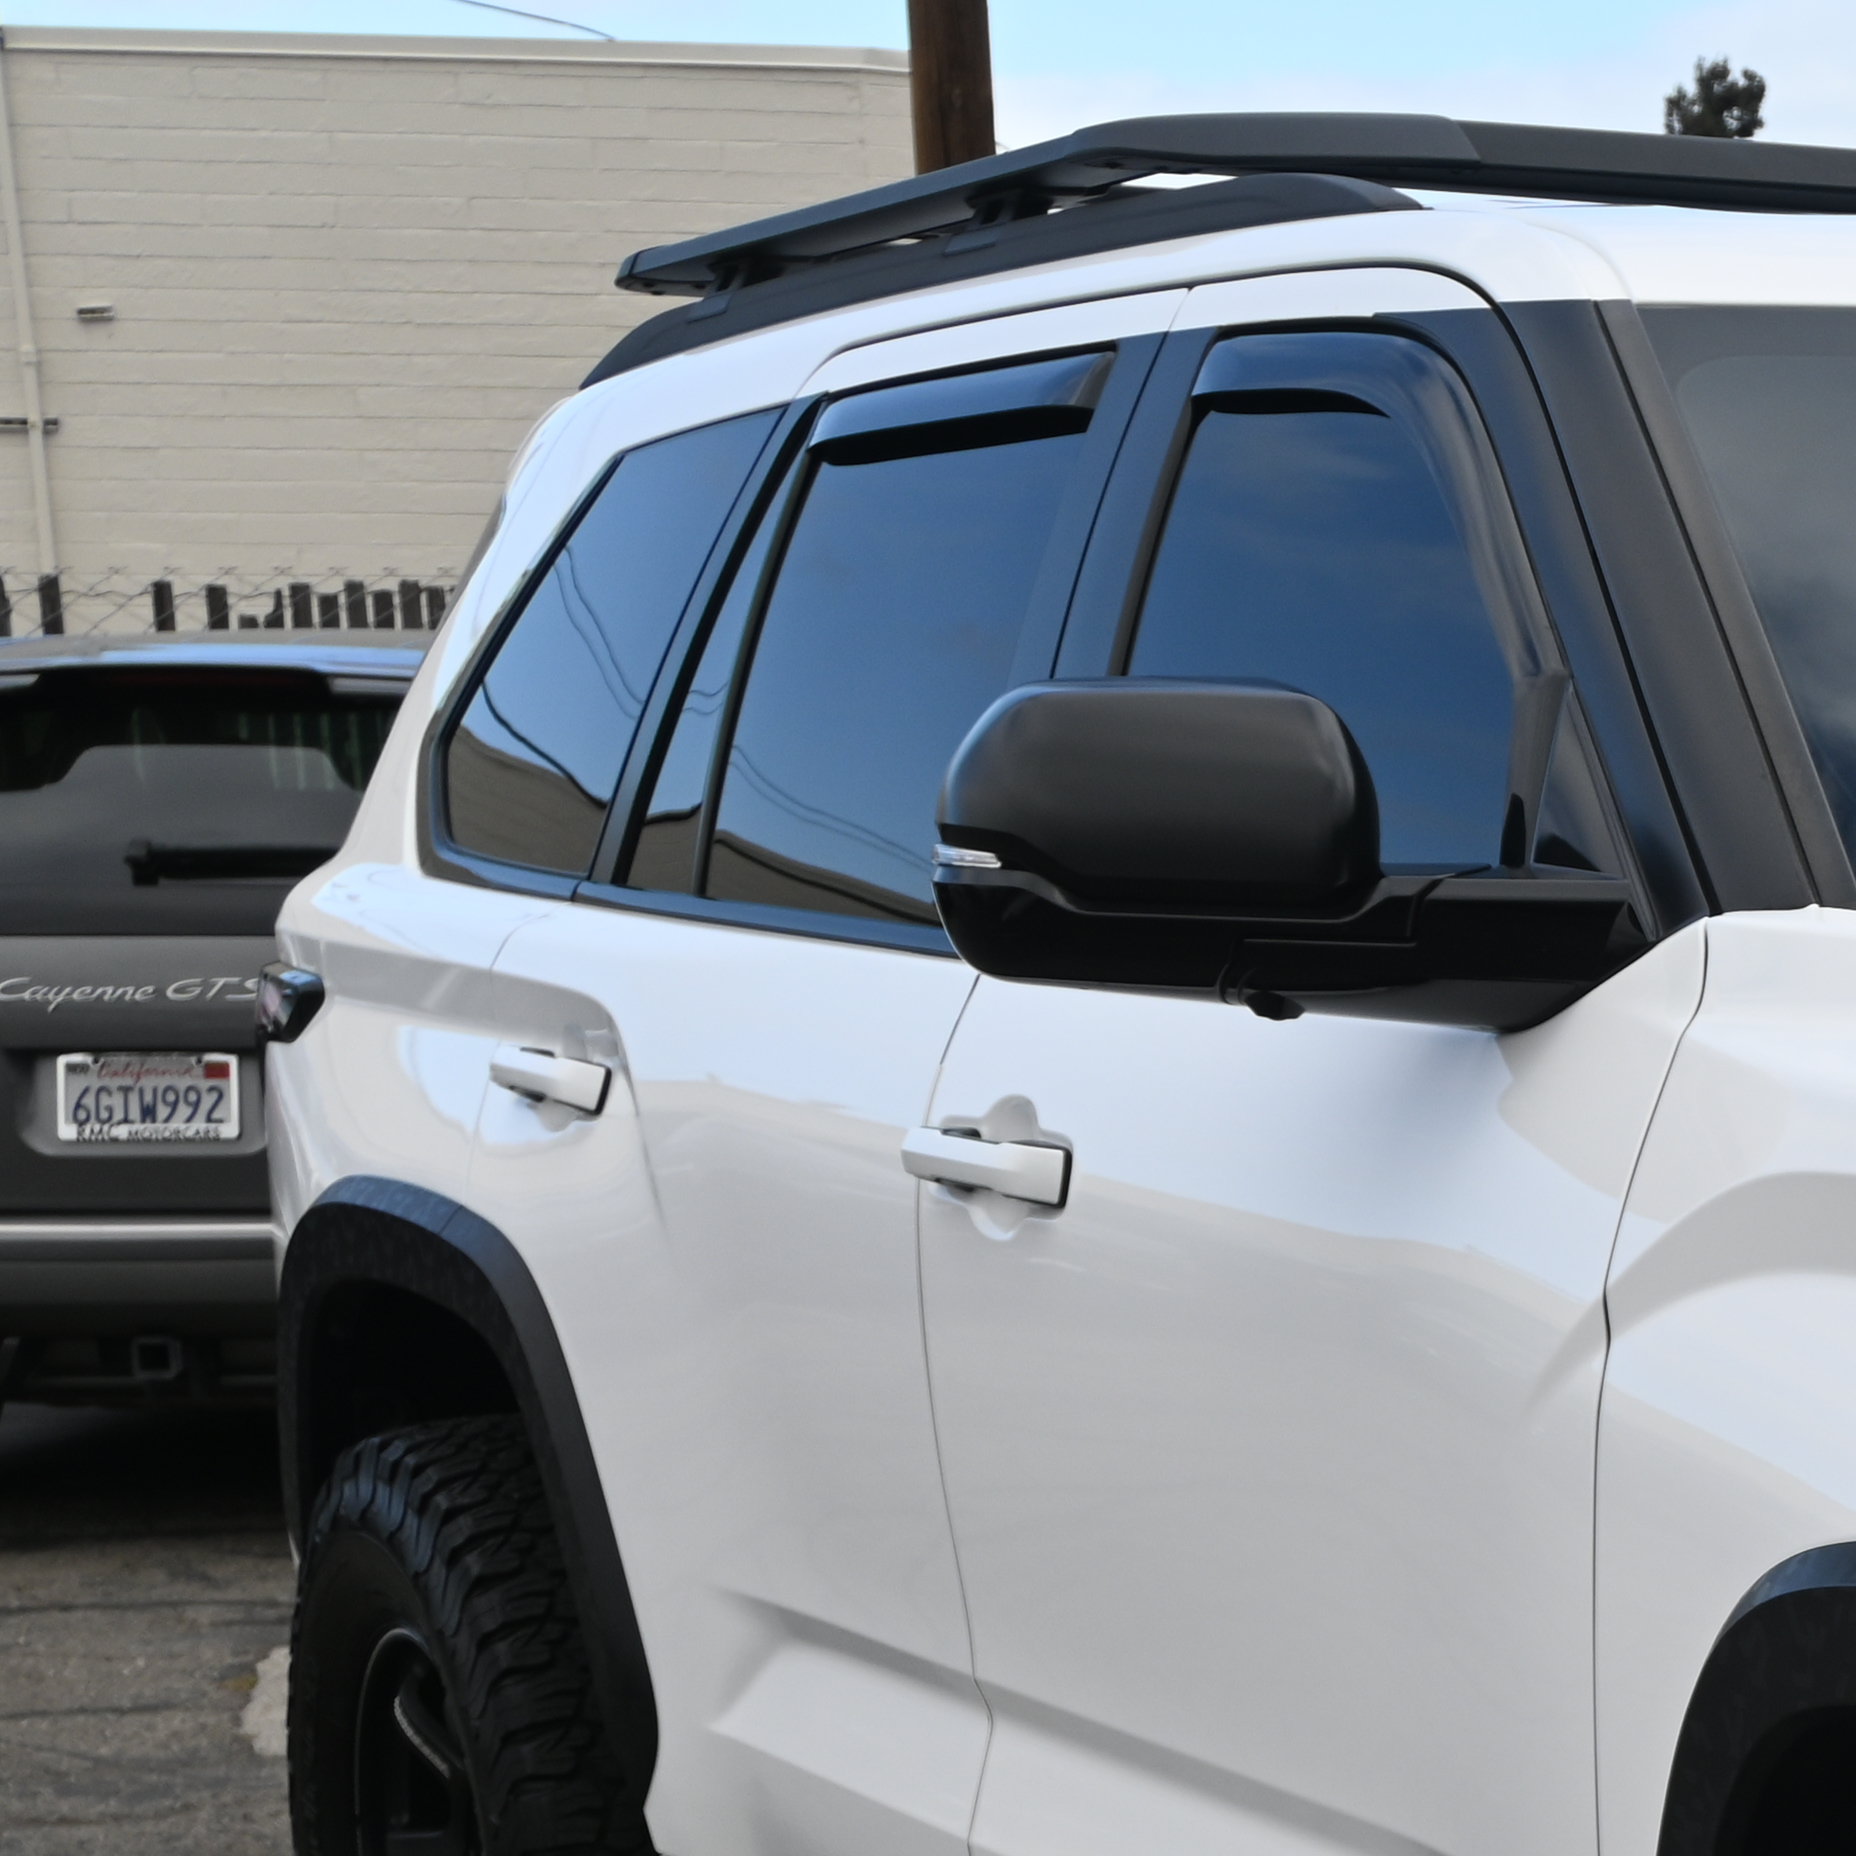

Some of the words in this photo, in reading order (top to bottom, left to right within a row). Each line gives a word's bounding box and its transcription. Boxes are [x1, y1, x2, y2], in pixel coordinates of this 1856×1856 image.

[0, 976, 157, 1013] Cayenne
[165, 976, 259, 1001] GTS
[72, 1084, 224, 1125] 6GIW992
